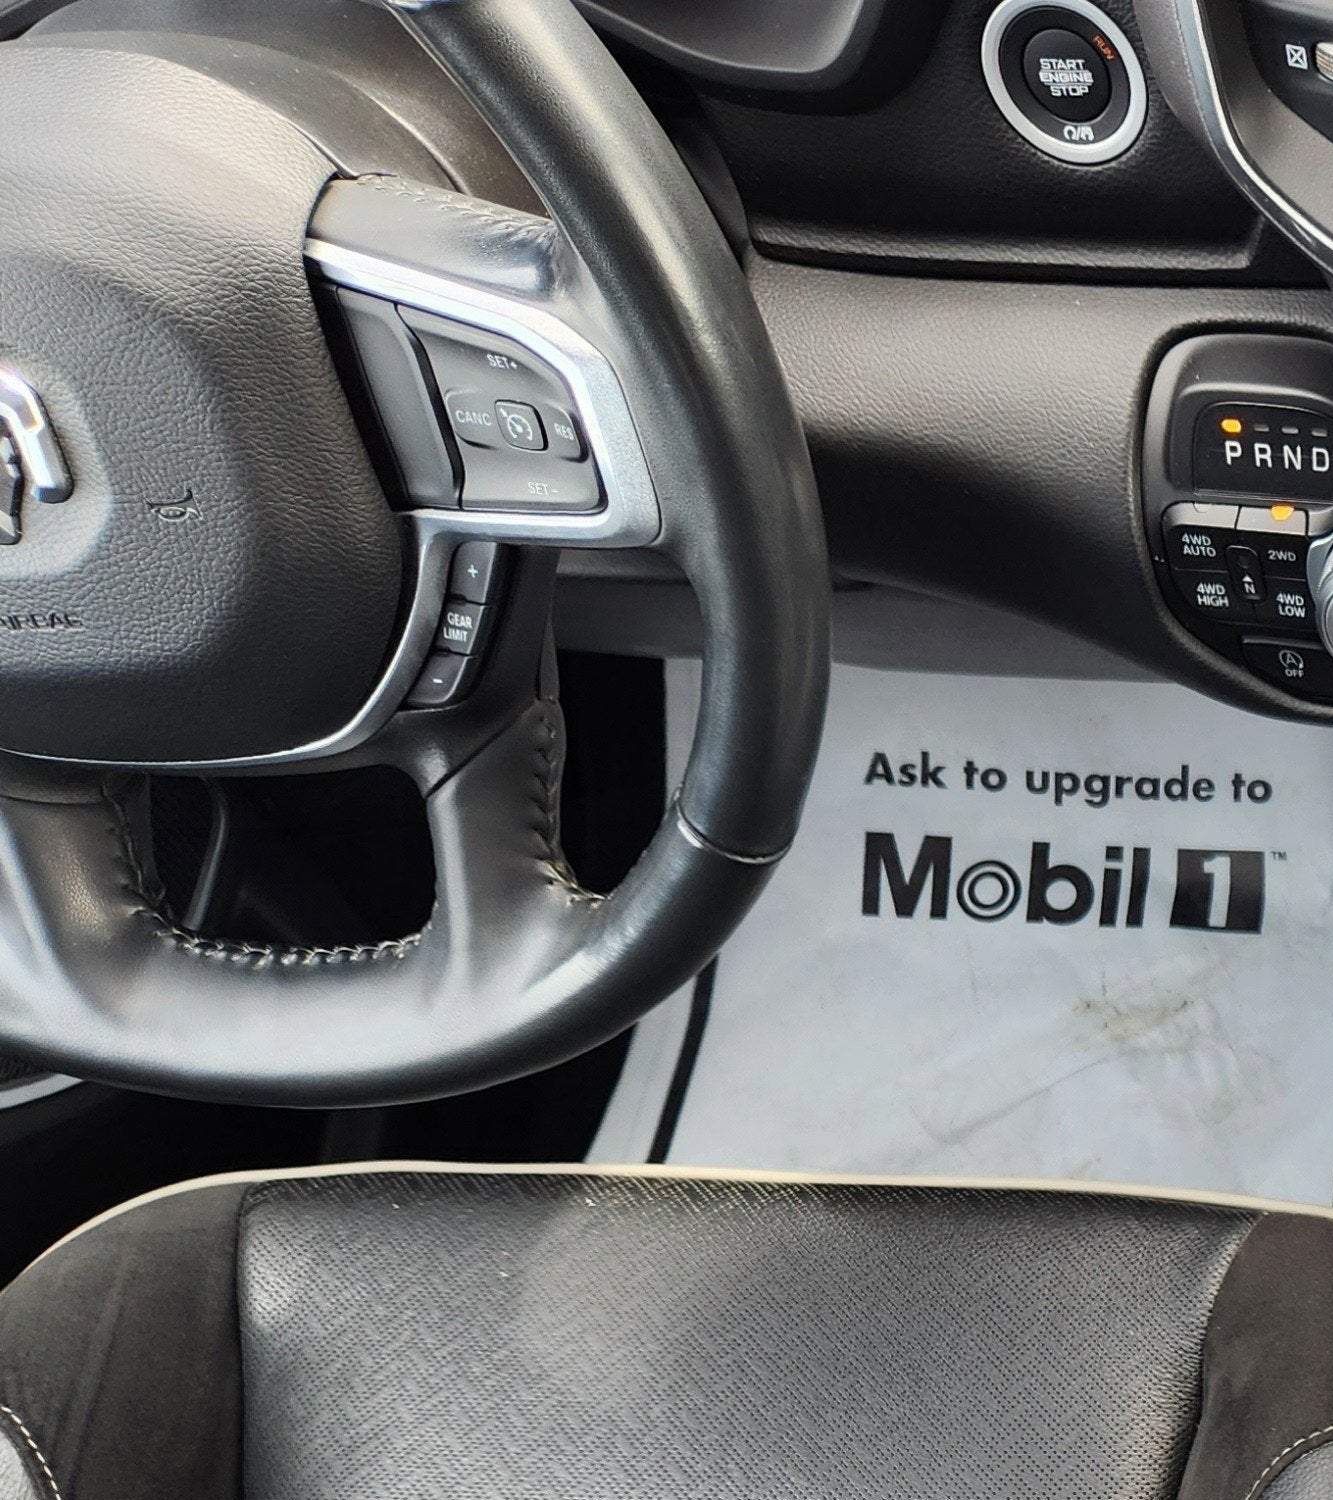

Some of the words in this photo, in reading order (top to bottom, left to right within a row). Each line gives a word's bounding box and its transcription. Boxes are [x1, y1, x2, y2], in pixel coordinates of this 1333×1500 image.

[1094, 35, 1115, 60] RUN
[1040, 58, 1085, 70] START
[1039, 72, 1094, 83] ENGINE
[1050, 86, 1089, 96] STOP
[456, 410, 492, 426] CANC
[554, 423, 574, 440] RES
[1181, 533, 1212, 546] 4WD
[1183, 544, 1216, 558] AUTO
[1268, 550, 1296, 562] 2WD
[1196, 583, 1226, 596] 4WD
[1244, 582, 1256, 594] N
[1197, 594, 1229, 608] HIGH
[1276, 594, 1304, 606] 4WD
[1278, 605, 1306, 618] LOW
[447, 612, 472, 629] GEAR
[443, 626, 468, 642] LIMIT
[1285, 668, 1304, 678] OFF
[864, 752, 948, 789] Ask
[964, 760, 1008, 792] to
[1026, 764, 1216, 808] upgrade
[1232, 773, 1273, 804] to
[862, 831, 1151, 928] Mobil
